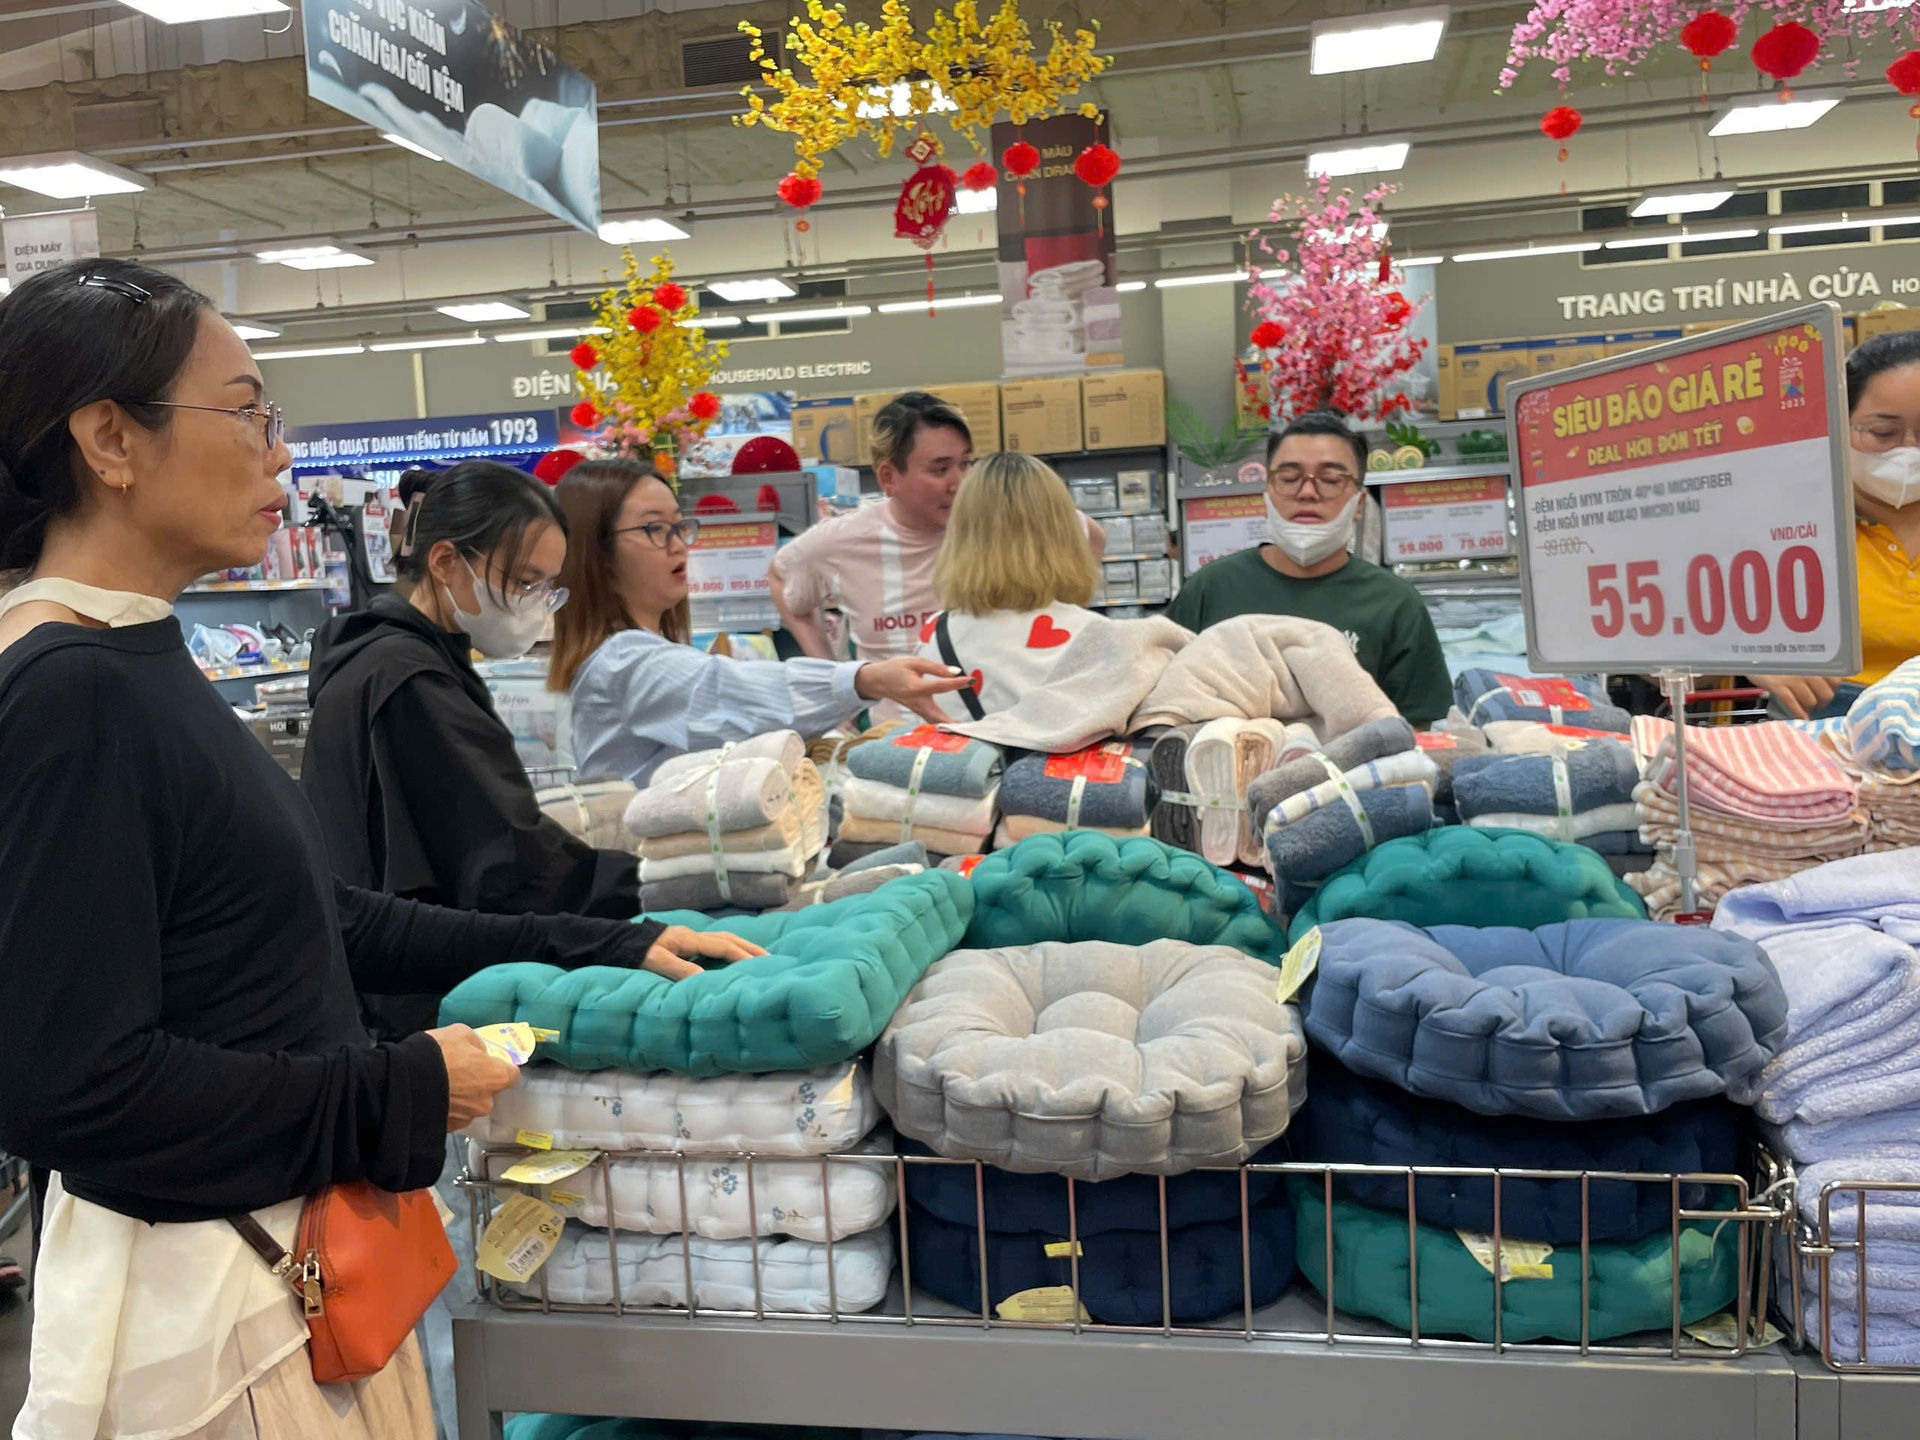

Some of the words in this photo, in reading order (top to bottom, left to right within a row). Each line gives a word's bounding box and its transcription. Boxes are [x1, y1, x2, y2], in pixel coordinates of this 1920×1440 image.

[407, 6, 446, 56] KHĂN
[432, 65, 465, 113] NỆM
[40, 240, 62, 253] MÁY
[16, 261, 34, 272] GIA
[1556, 288, 1665, 320] TRANG
[1672, 277, 1727, 312] TRÍ
[1732, 272, 1802, 306] NHÀ
[1808, 265, 1882, 300] CỬA
[512, 369, 571, 400] ĐIỆN
[797, 360, 872, 379] ELECTRIC
[1552, 395, 1602, 438] SIÊU
[1607, 382, 1663, 428] BÃO
[1667, 363, 1720, 414] GIÁ
[1722, 351, 1765, 403] RẺ
[1780, 397, 1806, 410] 2025
[310, 437, 338, 460] HIỆU
[338, 437, 370, 458] QUẠT
[406, 429, 441, 452] TIẾNG
[441, 428, 460, 449] TỪ
[461, 427, 489, 448] NĂM
[490, 416, 538, 446] 1993
[1587, 443, 1622, 467] DEAL
[1657, 428, 1689, 454] ĐÓN
[1692, 419, 1723, 447] TẾT
[1579, 492, 1603, 508] MYM
[1667, 472, 1733, 495] MICROFIBER
[1581, 511, 1604, 528] MYM
[1640, 501, 1674, 519] MICRO
[1770, 523, 1818, 542] VND/CÁI
[1586, 545, 1825, 639] 55.000
[873, 614, 917, 632] HOLD
